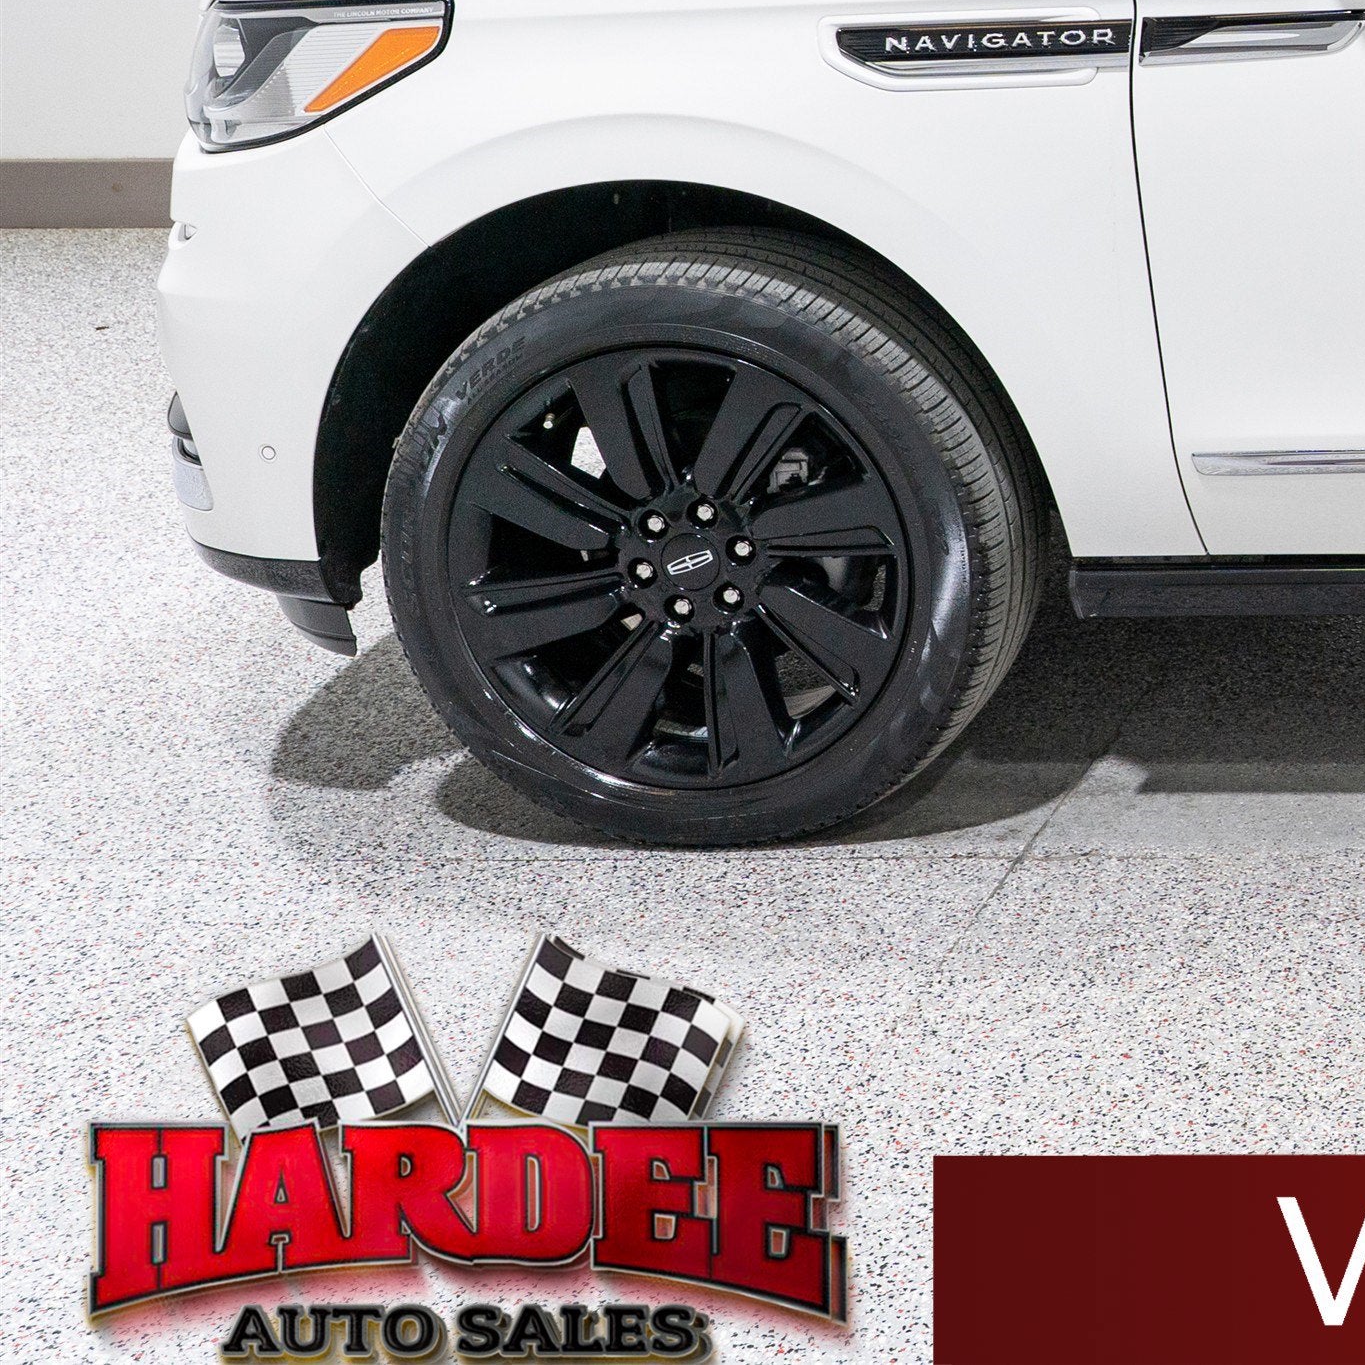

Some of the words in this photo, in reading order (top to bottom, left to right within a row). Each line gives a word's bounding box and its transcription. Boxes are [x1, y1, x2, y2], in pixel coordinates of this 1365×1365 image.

[333, 11, 345, 19] THE
[347, 10, 375, 18] LINCOLN
[376, 8, 400, 17] MOTOR
[401, 6, 434, 15] COMPANY
[885, 28, 1117, 53] NAVIGATOR
[455, 336, 526, 400] VERDE
